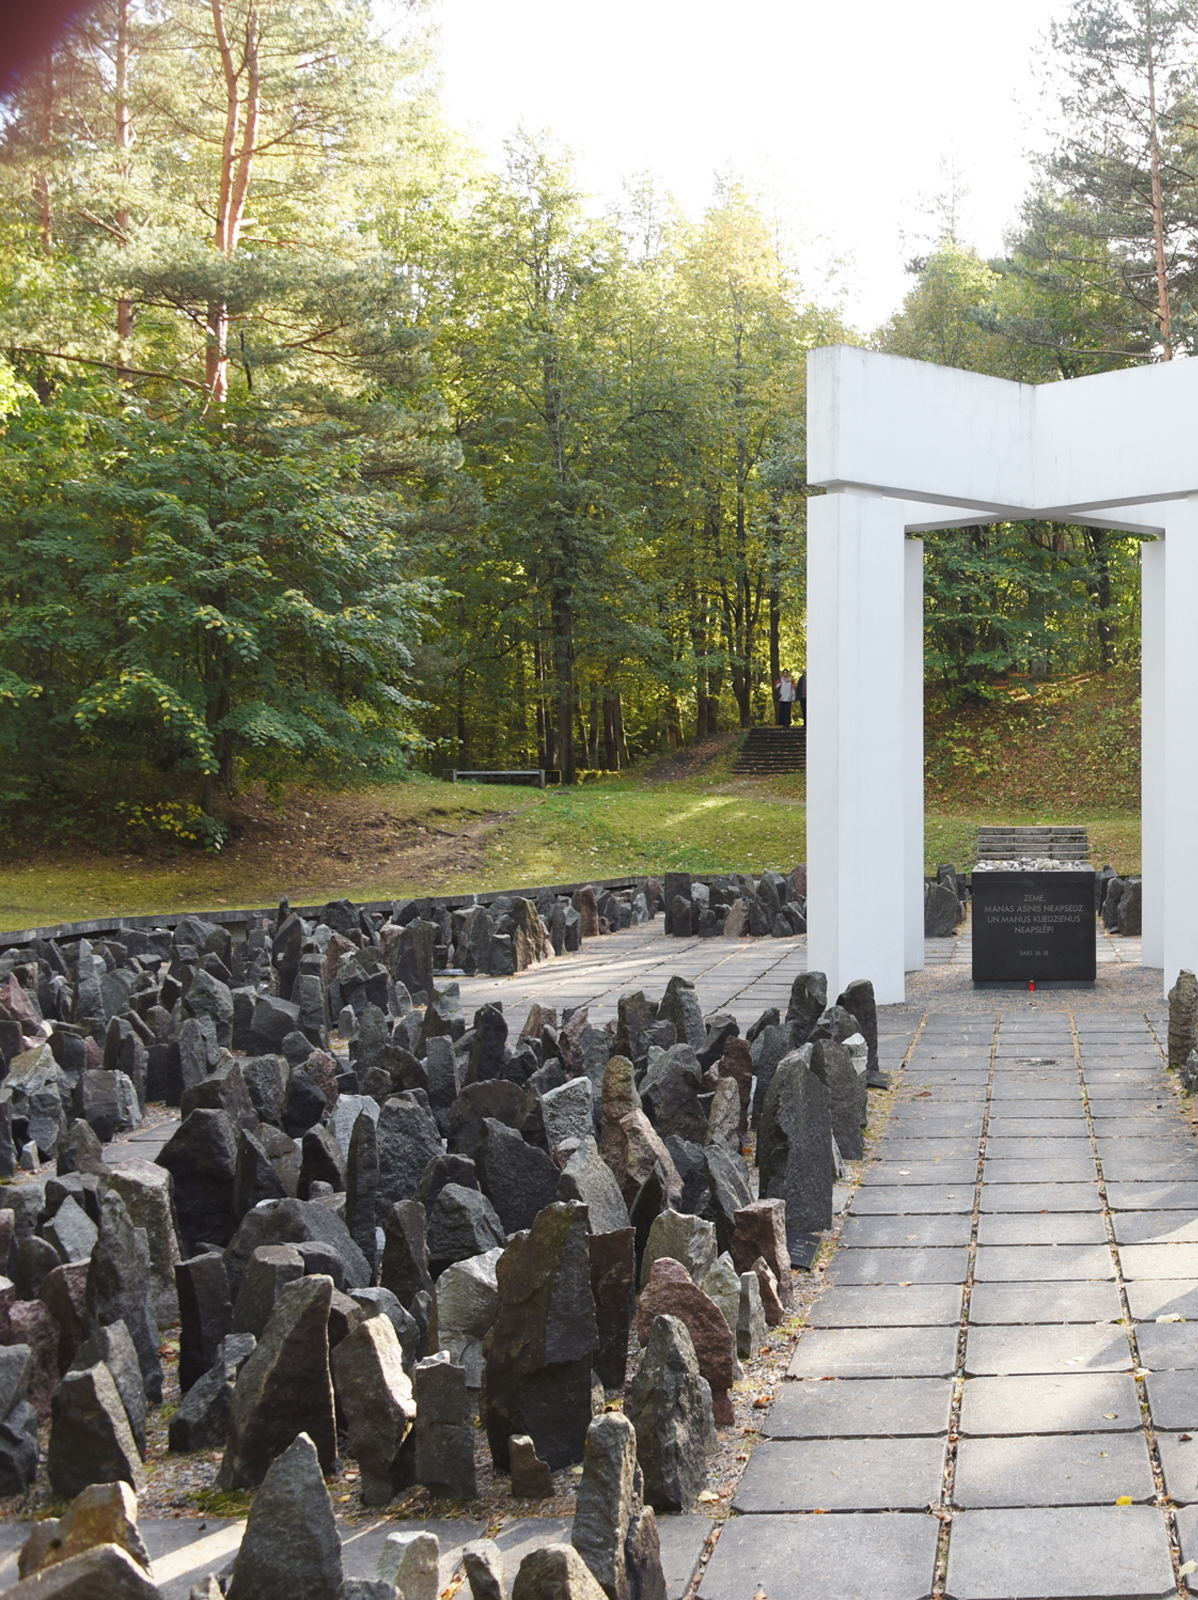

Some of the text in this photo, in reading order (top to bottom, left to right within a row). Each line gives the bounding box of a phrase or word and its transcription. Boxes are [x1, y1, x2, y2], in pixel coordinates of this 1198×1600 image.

[1023, 894, 1046, 903] ZEME,
[984, 904, 1083, 913] MANAS ASINIS NEAPSEDZ
[987, 913, 1080, 923] UN MANUS KLIEDZIENUS
